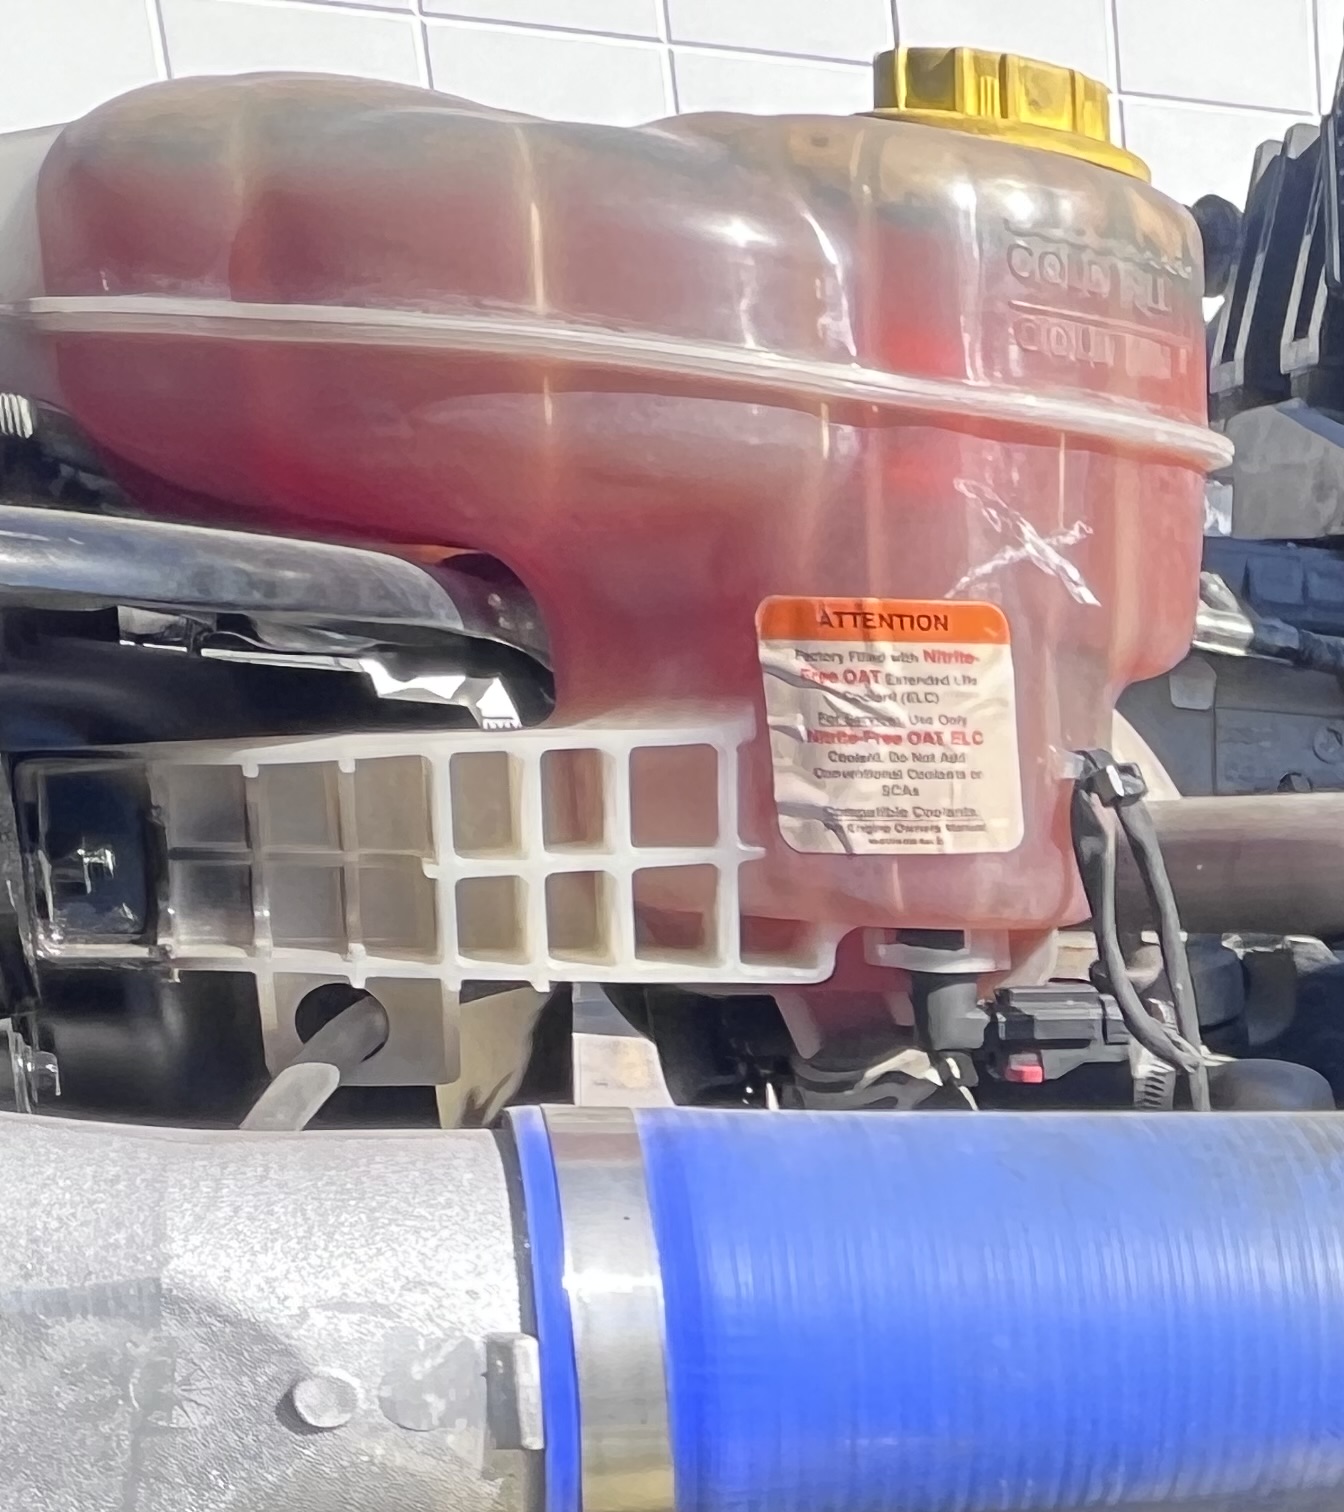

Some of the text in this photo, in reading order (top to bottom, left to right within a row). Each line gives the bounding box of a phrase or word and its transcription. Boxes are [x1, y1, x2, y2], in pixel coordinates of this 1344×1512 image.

[818, 608, 950, 632] ATTENTION
[843, 669, 881, 685] OAT
[907, 730, 945, 746] OAT
[949, 730, 984, 746] ELC
